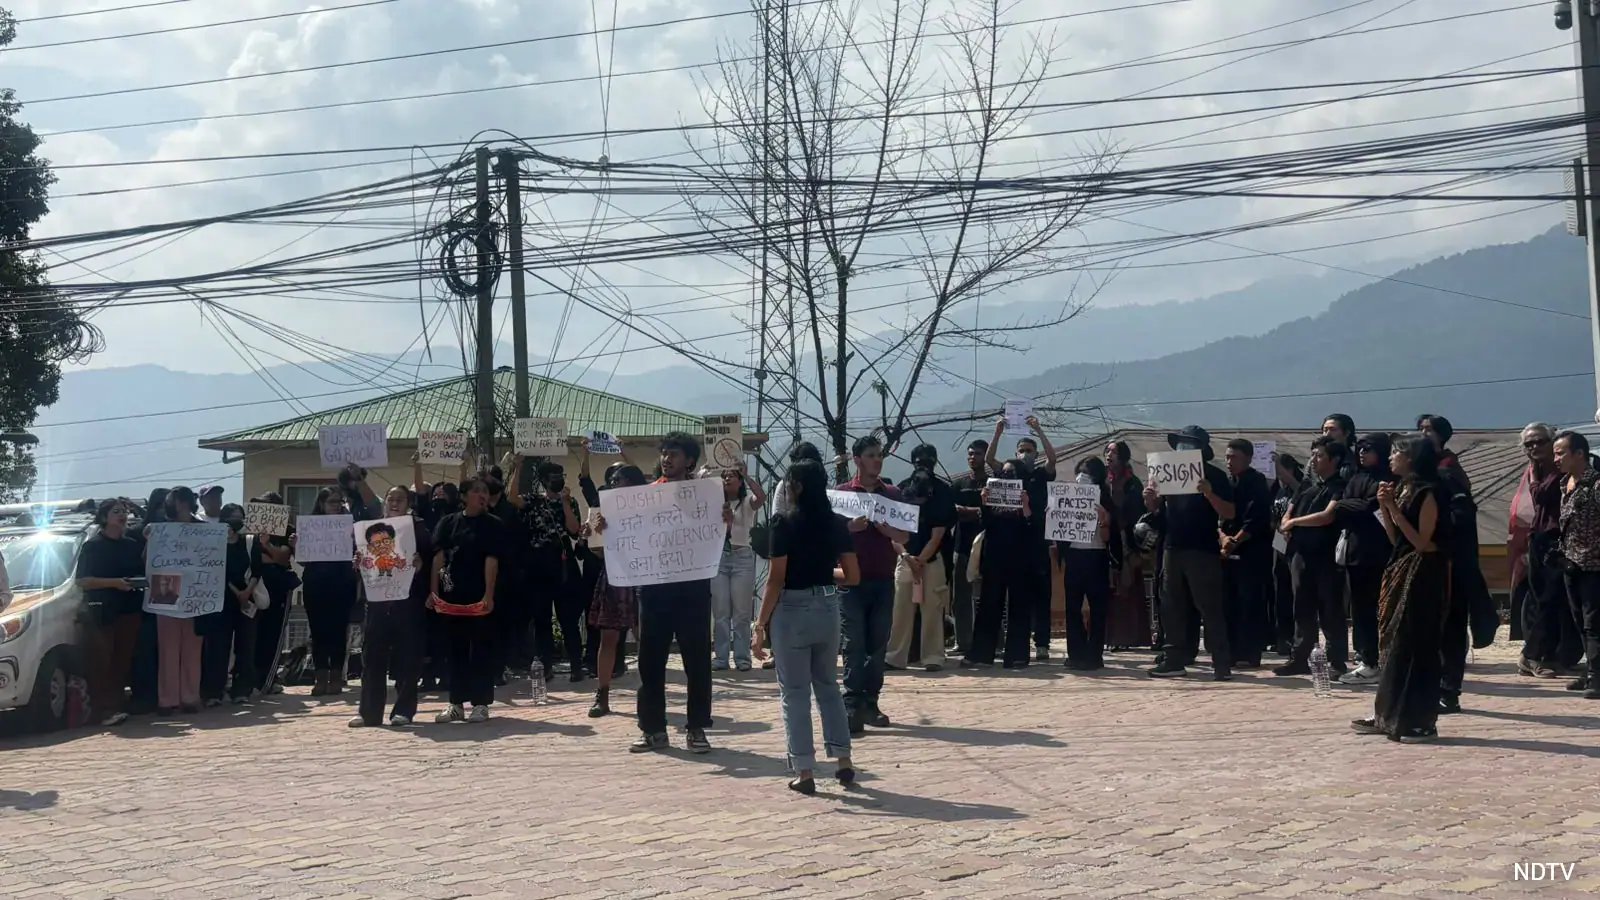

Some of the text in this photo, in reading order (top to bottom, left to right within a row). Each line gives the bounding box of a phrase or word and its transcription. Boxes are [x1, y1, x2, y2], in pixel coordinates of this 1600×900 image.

[517, 421, 556, 429] NO MEANS
[593, 431, 609, 440] NO
[424, 440, 464, 449] GO BACK
[540, 440, 552, 448] FOR
[556, 439, 568, 447] PM
[421, 449, 462, 458] GO BACK
[1051, 485, 1095, 496] KEEP YOUR
[1059, 498, 1094, 508] FACIST
[874, 503, 886, 515] GO
[890, 508, 916, 523] BACK
[261, 514, 286, 528] BACK
[649, 524, 722, 548] GOVERNOR
[183, 599, 215, 614] BRO
